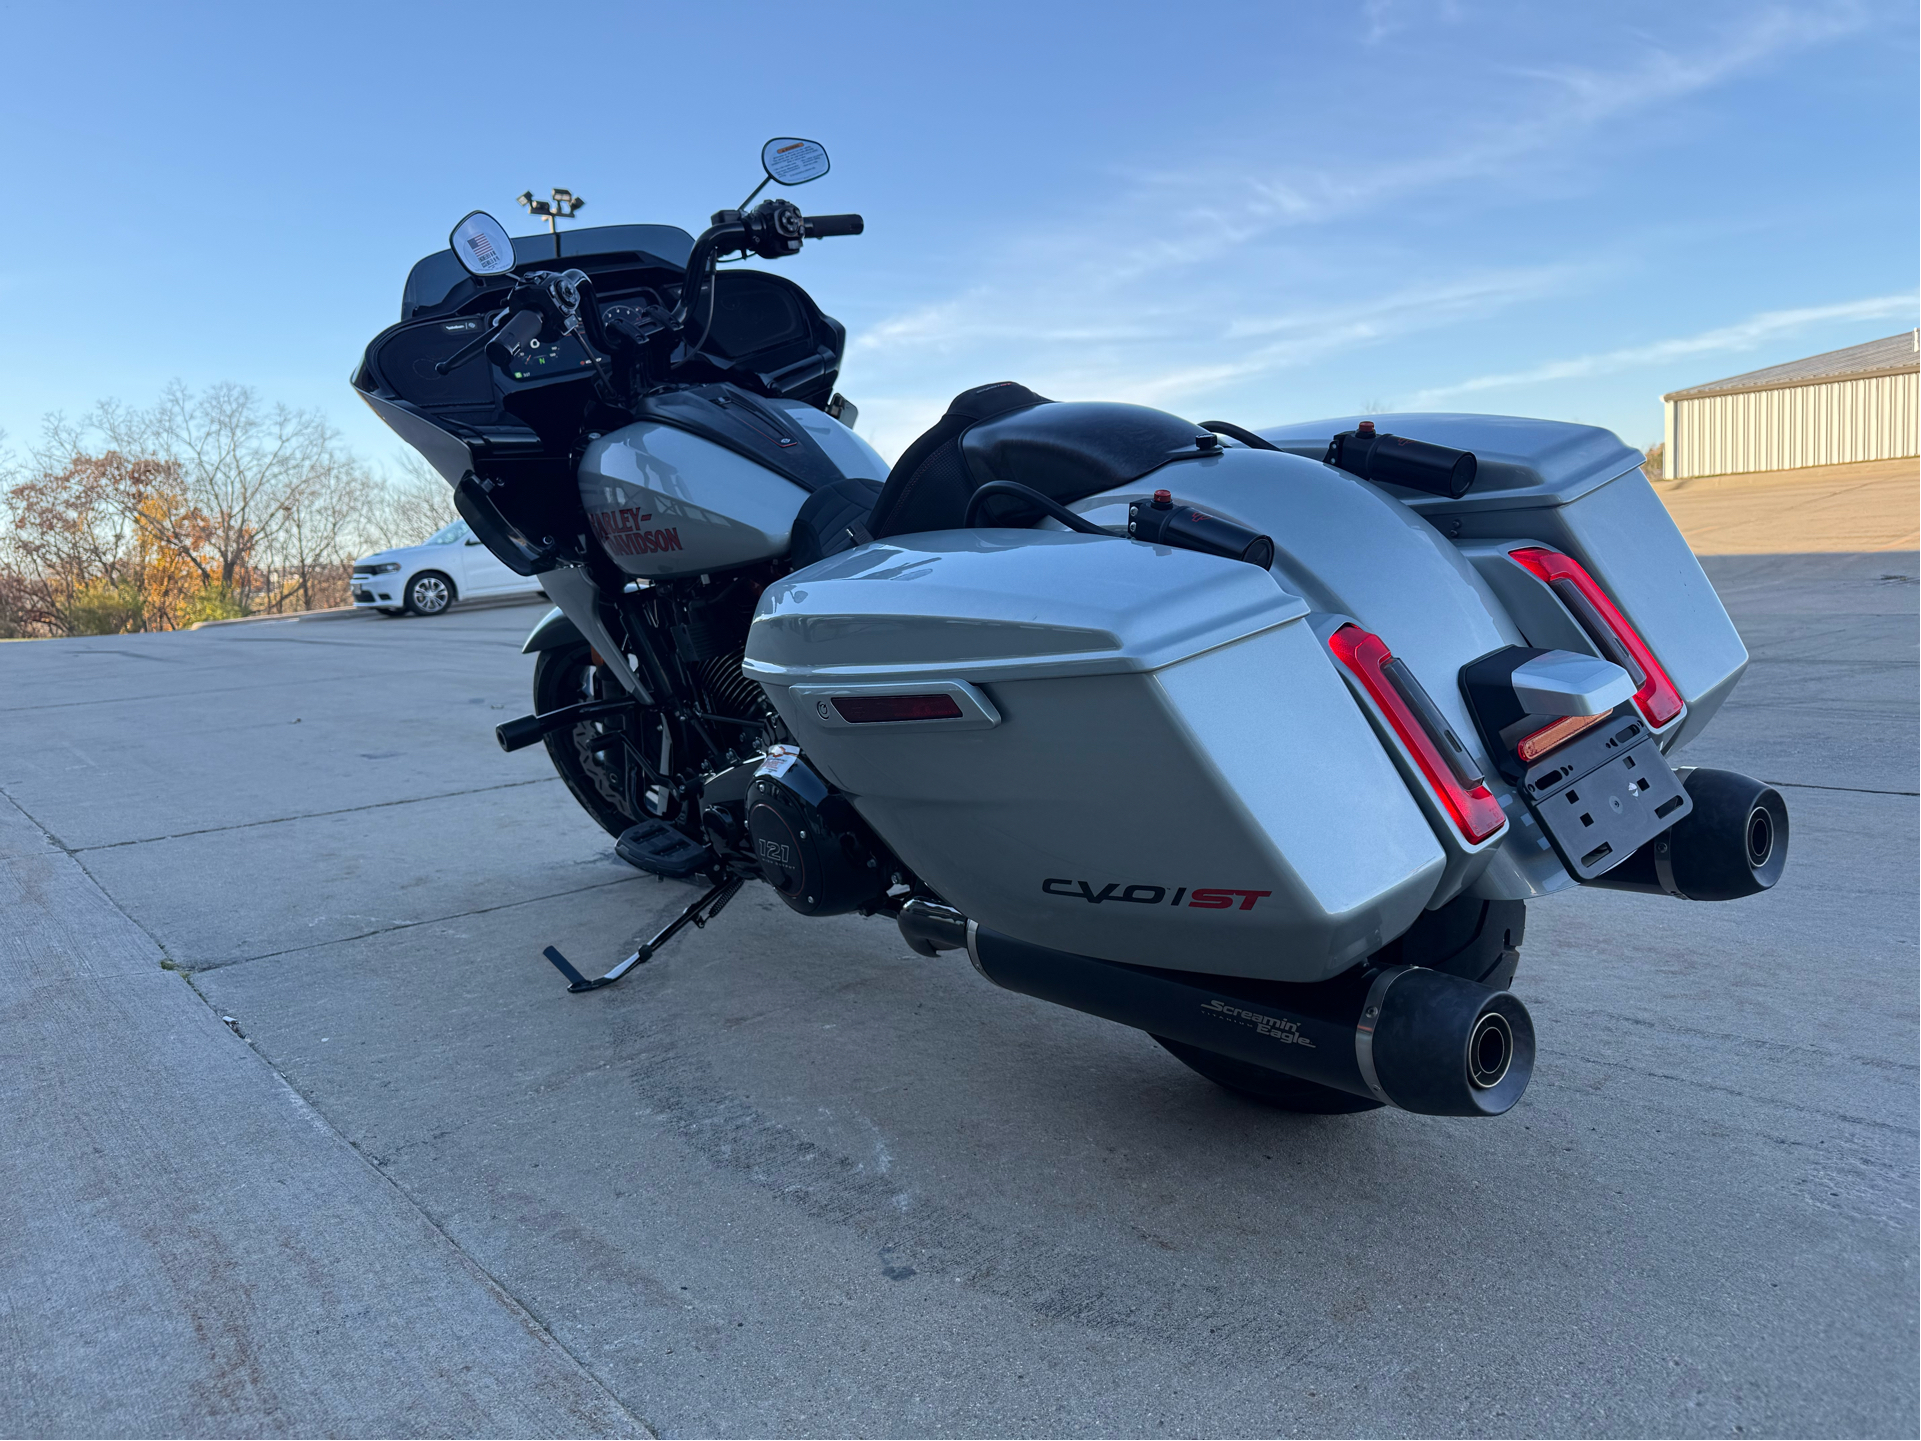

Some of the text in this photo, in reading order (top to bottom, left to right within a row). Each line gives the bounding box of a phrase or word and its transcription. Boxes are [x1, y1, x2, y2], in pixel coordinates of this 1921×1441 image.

[610, 527, 684, 556] DAVIDSON
[759, 838, 790, 863] 121
[1256, 1023, 1316, 1048] Eagle
